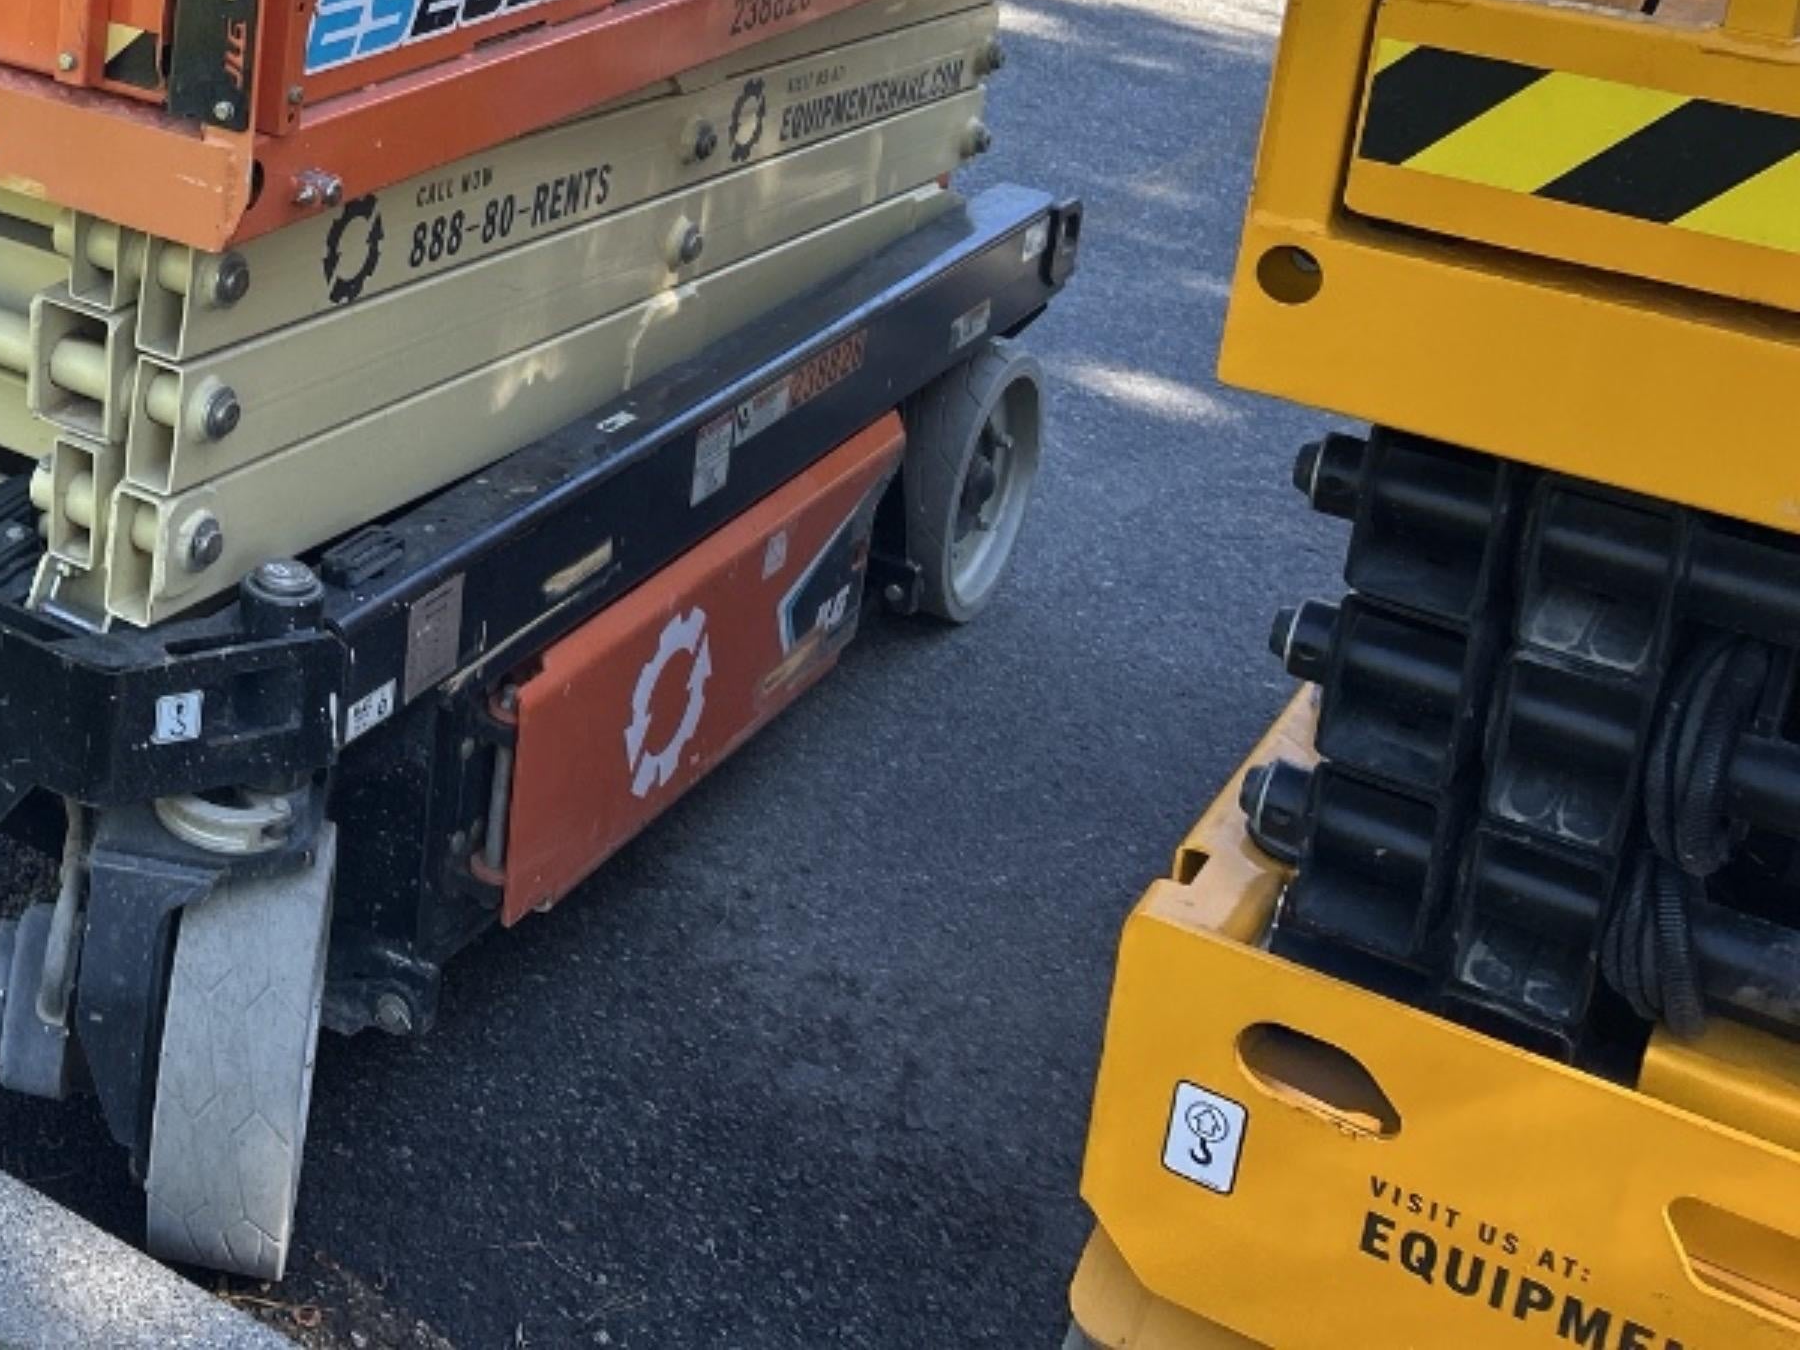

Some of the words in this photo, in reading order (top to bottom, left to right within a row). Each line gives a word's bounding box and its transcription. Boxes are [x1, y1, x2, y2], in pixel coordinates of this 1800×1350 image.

[408, 162, 613, 268] 888-80-RENTS
[415, 176, 454, 208] CALL
[1369, 1174, 1462, 1230] VISIT
[1477, 1220, 1521, 1257] US
[1537, 1248, 1592, 1284] AT:
